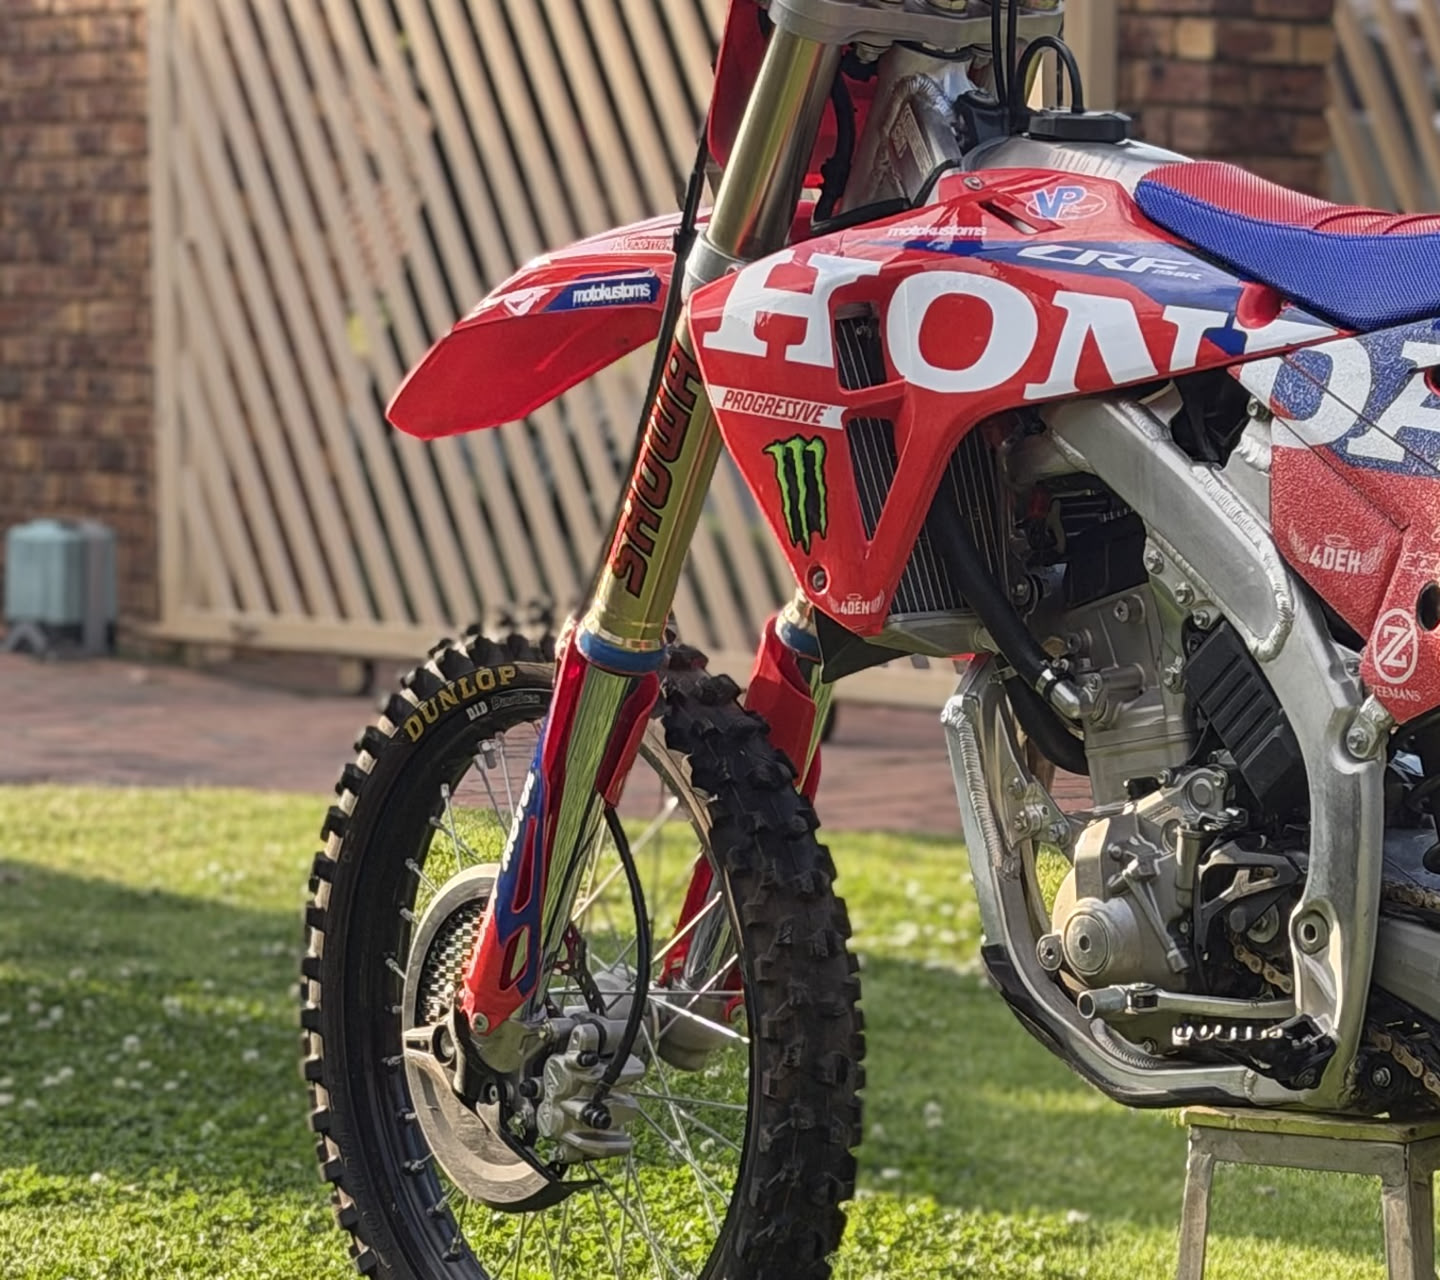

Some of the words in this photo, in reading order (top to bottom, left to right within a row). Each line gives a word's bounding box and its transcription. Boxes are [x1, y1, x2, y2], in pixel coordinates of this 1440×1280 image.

[1033, 185, 1087, 220] VP
[887, 223, 987, 238] motokustoms
[1018, 244, 1192, 273] CRF
[572, 281, 652, 304] motokustoms
[722, 389, 828, 424] PROGRESSIVE
[612, 337, 703, 599] SHOWA
[1308, 544, 1363, 575] 4DEH
[403, 665, 517, 743] DUNLOP
